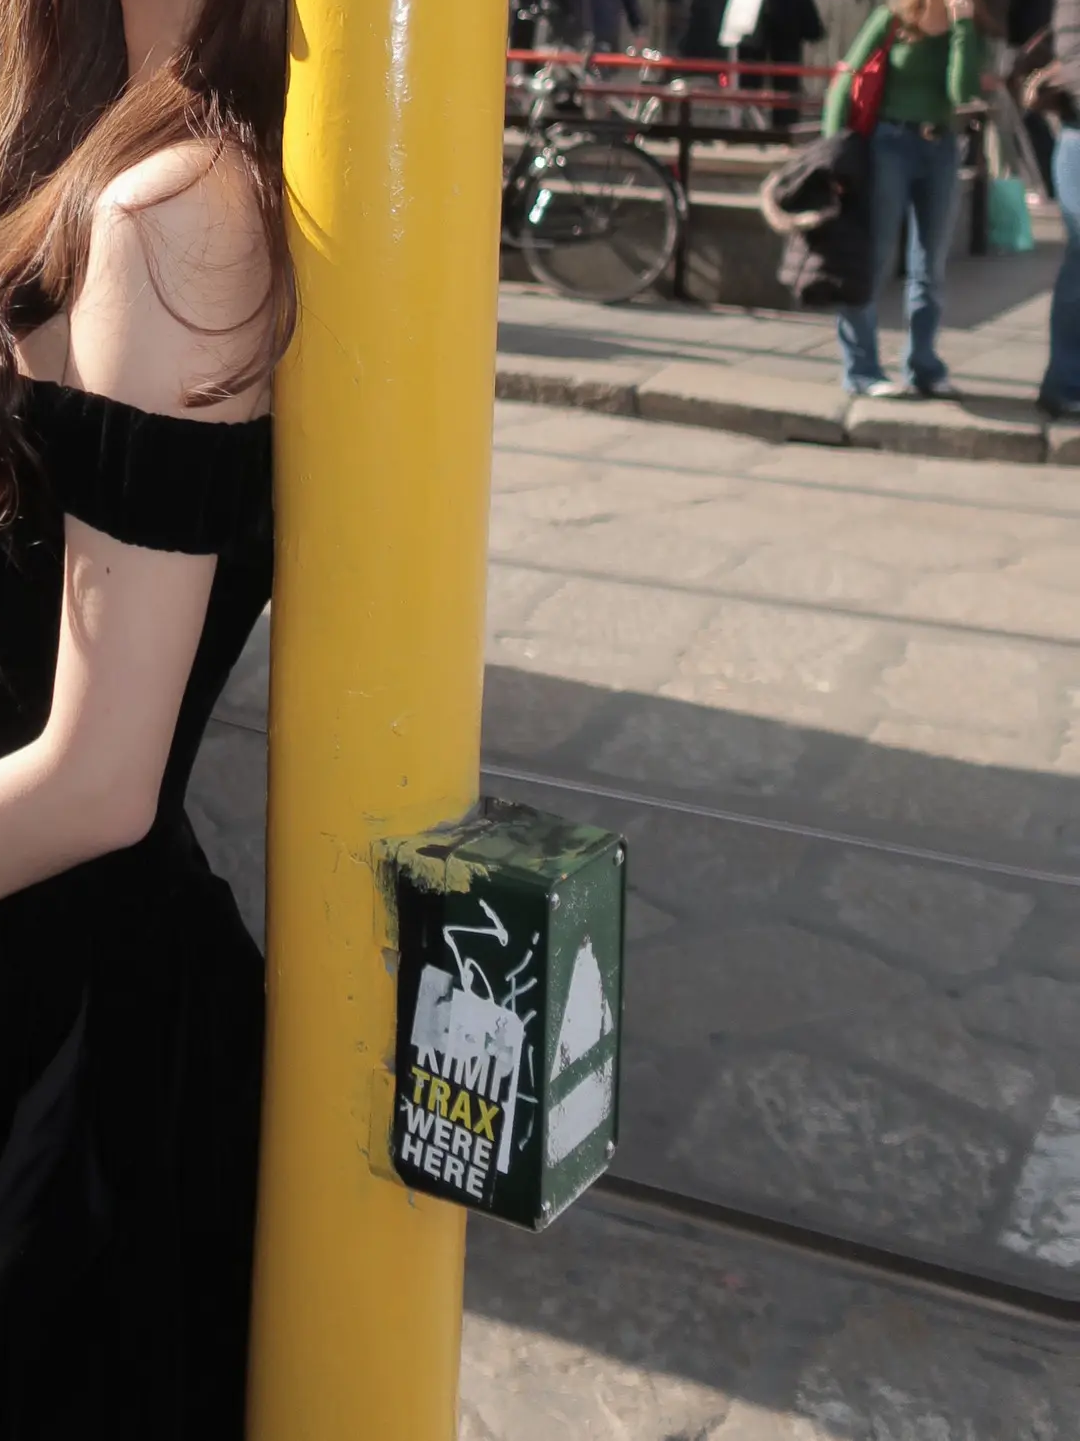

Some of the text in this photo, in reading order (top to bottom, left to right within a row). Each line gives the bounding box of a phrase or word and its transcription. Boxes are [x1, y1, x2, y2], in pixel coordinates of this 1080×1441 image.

[411, 1066, 500, 1142] TRAX
[400, 1133, 486, 1200] HERE
[404, 1105, 493, 1171] WERE
